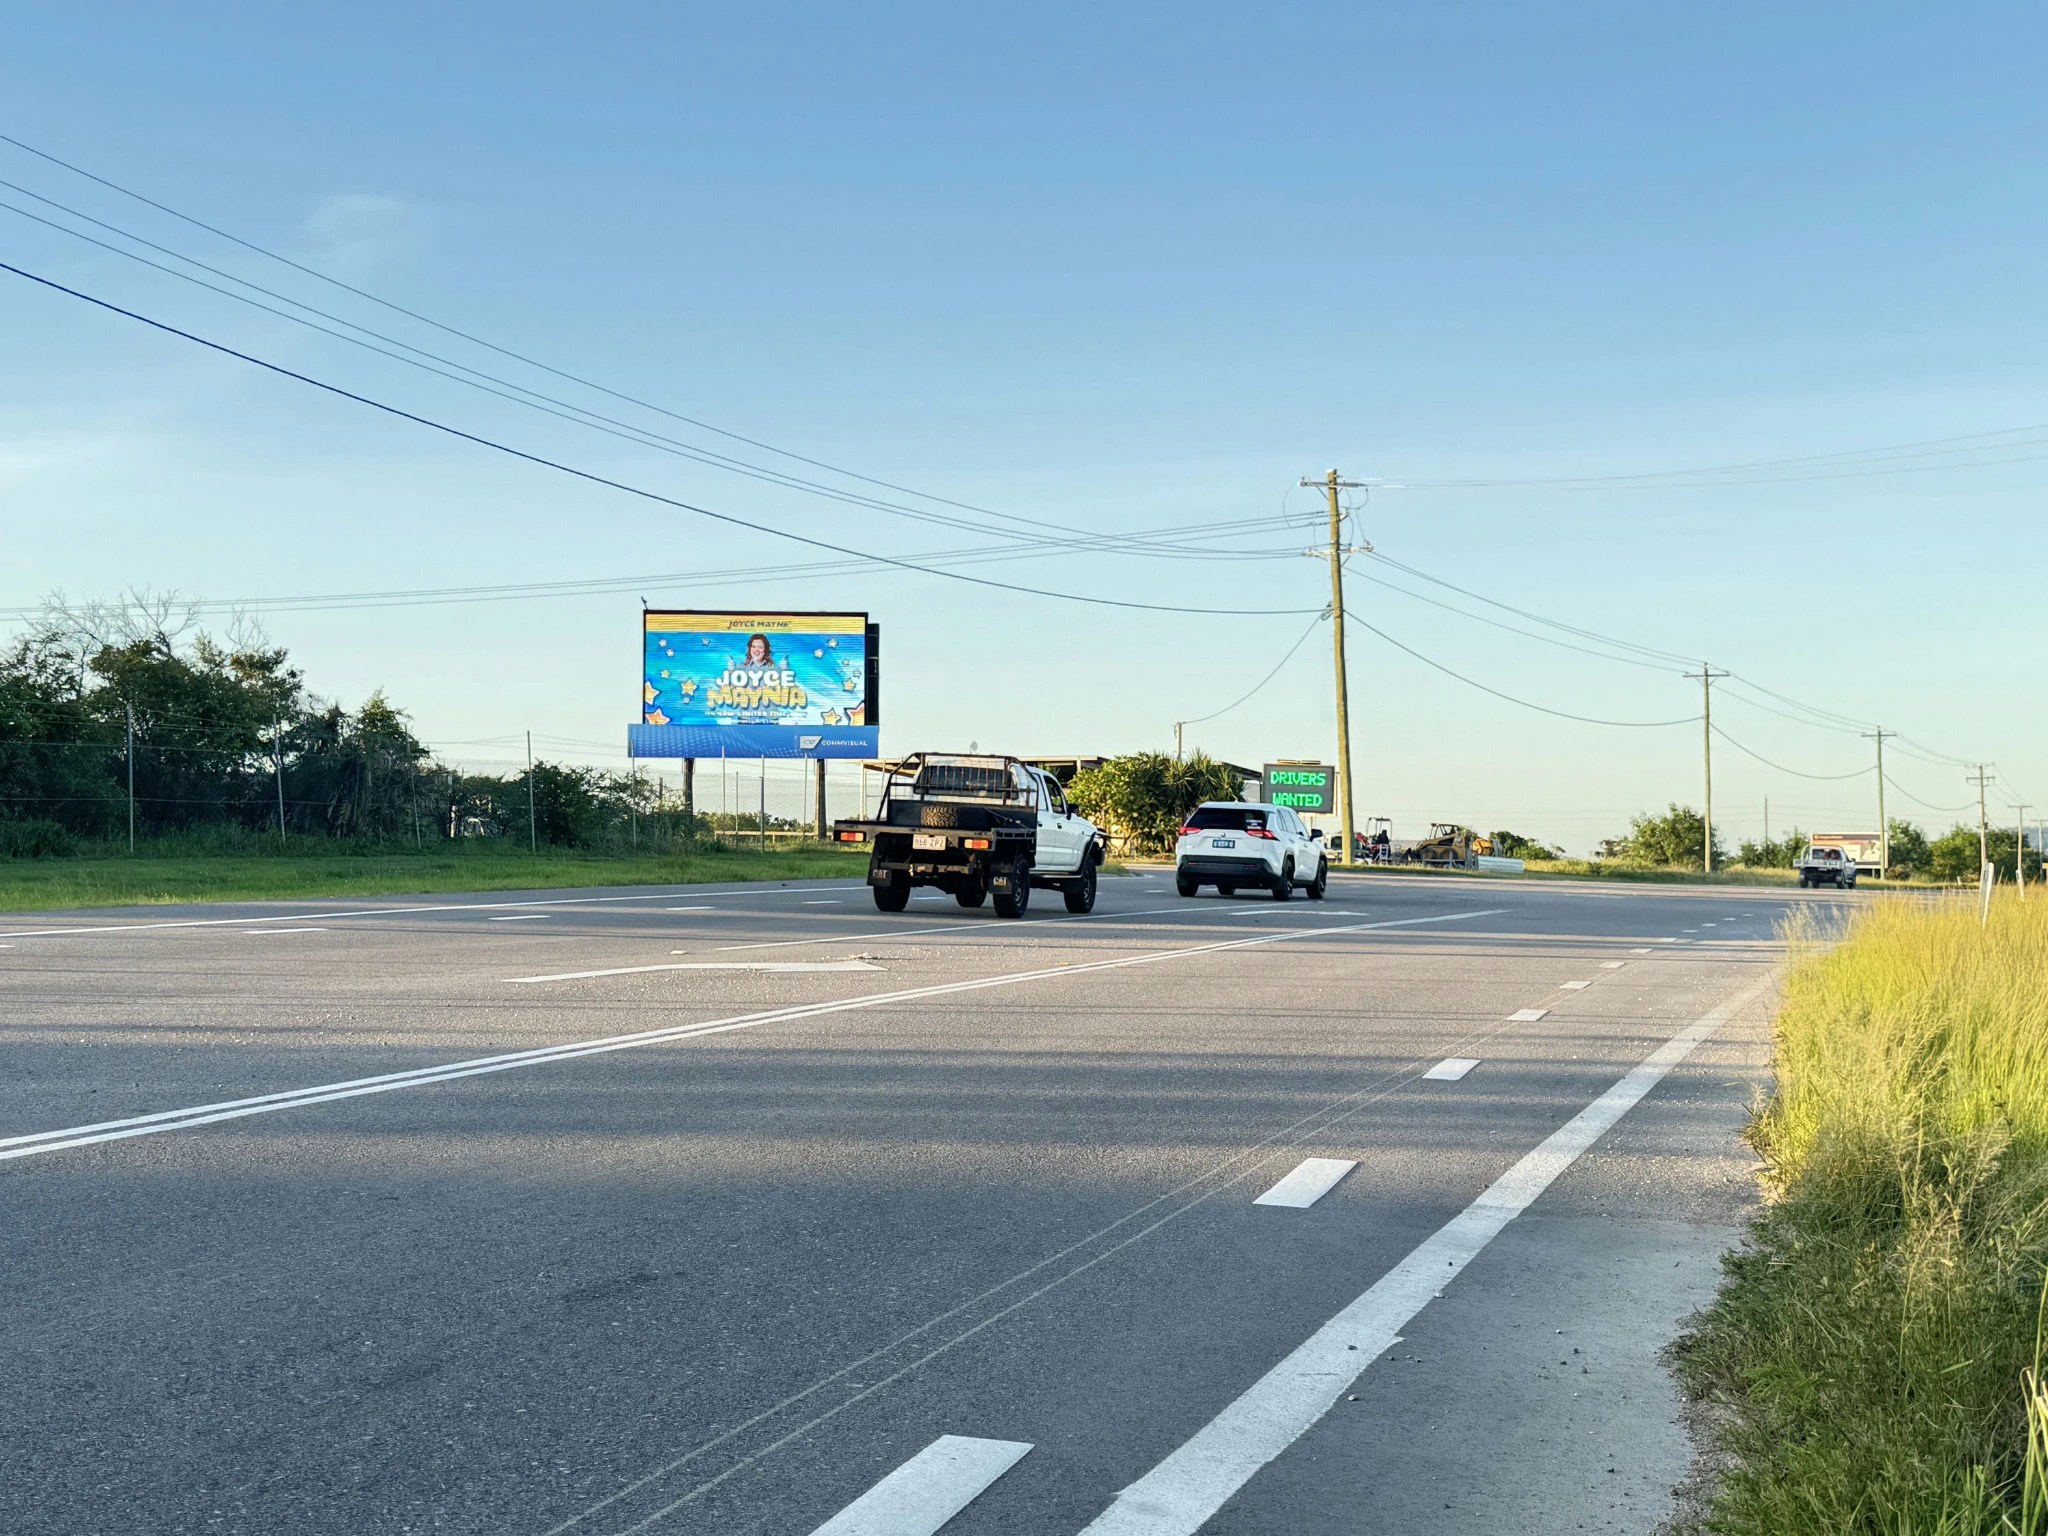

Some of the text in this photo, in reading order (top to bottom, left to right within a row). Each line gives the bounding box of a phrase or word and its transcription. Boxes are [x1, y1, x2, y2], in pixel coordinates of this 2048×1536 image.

[727, 620, 756, 630] JOYCE
[716, 669, 796, 687] JOYCE
[706, 684, 808, 710] MAYNIA
[821, 739, 868, 747] COMMVISUAL
[1270, 770, 1327, 786] DRIVERS
[1272, 792, 1323, 807] WANTED
[872, 869, 889, 879] CAT
[993, 876, 1008, 886] CAT
